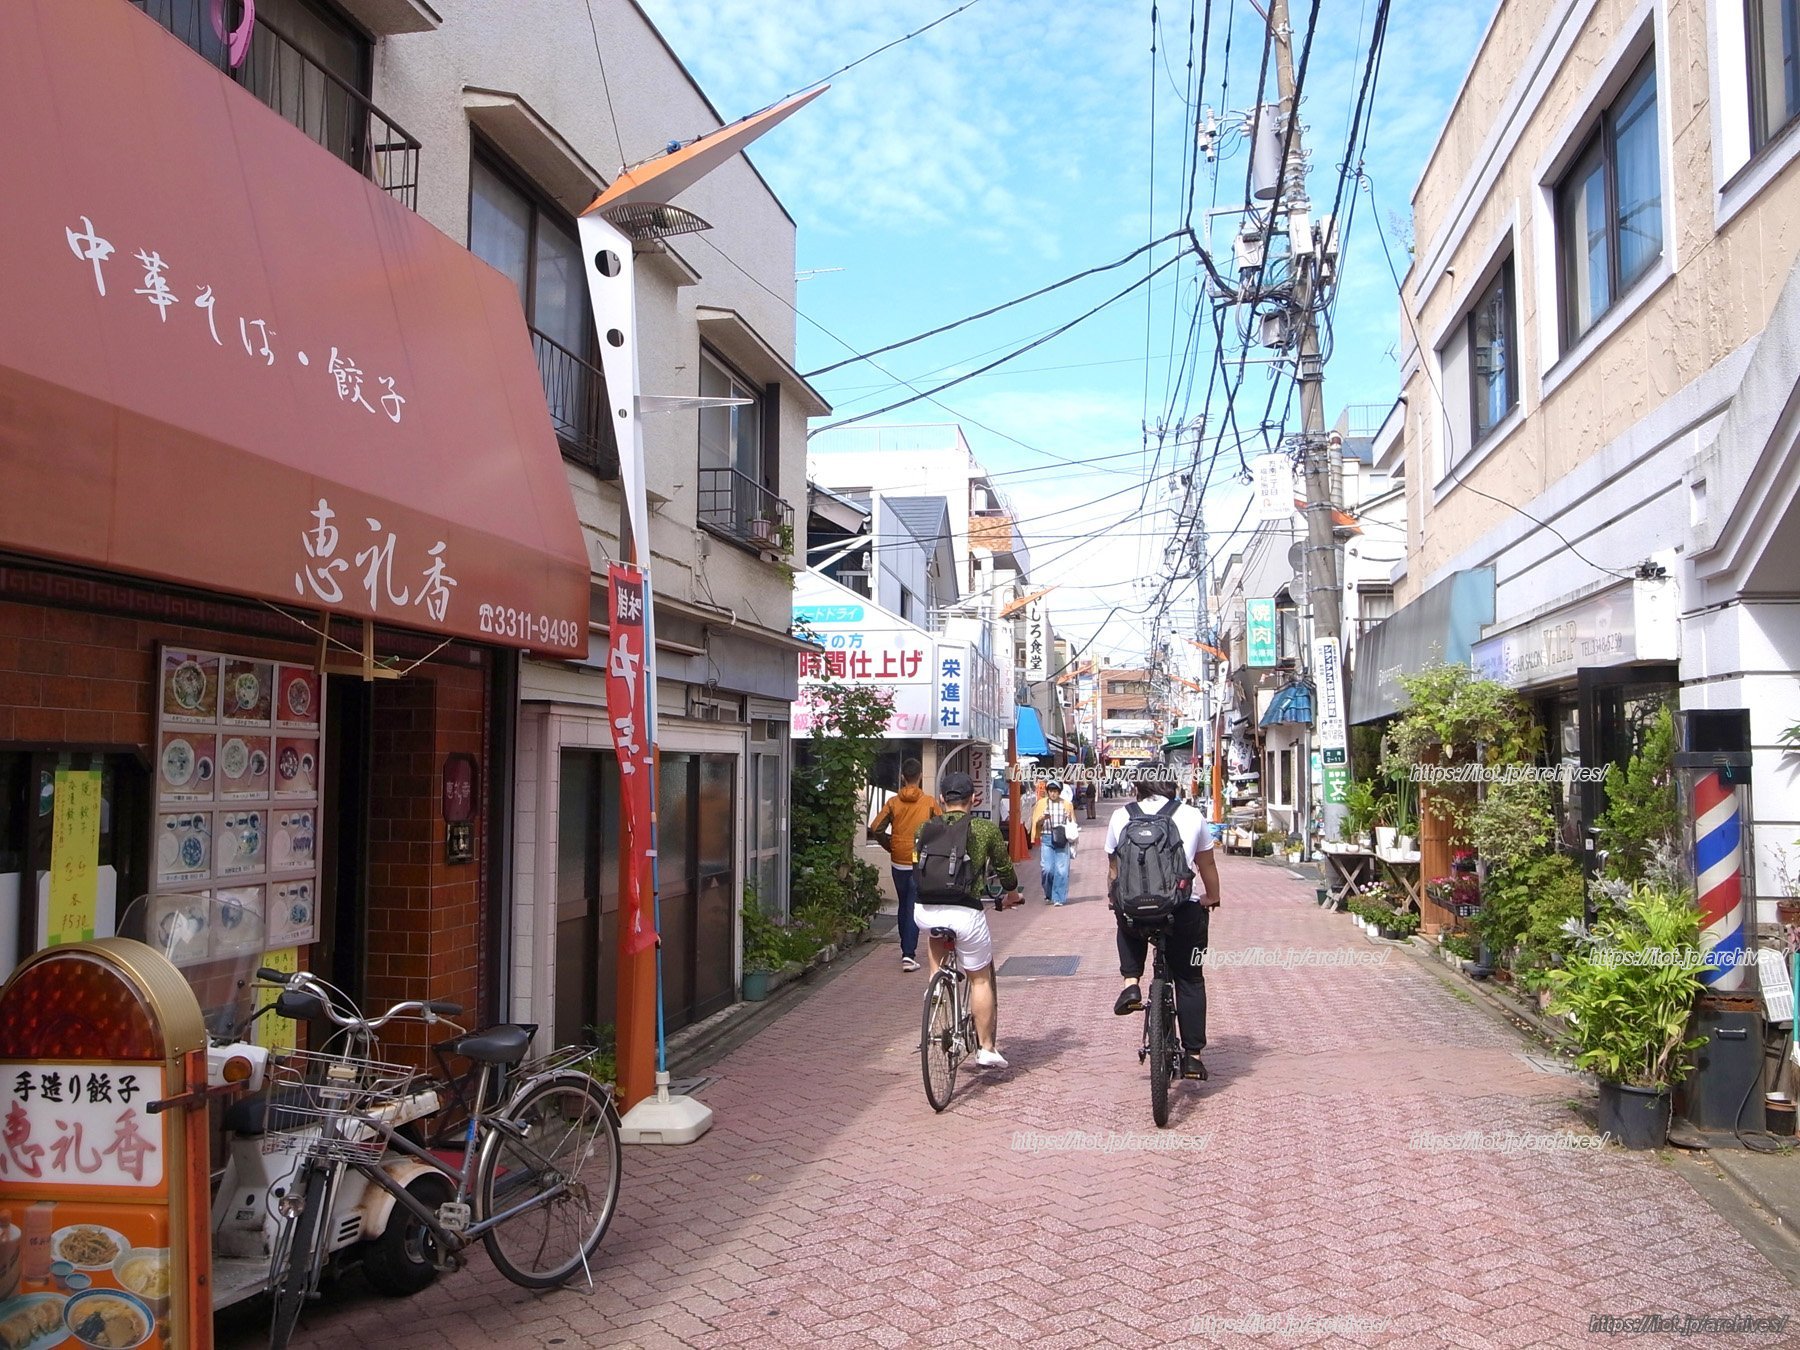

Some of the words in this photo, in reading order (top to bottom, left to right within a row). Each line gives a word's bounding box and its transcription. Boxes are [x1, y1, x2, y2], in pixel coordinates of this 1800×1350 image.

[295, 498, 458, 623] 恵礼香
[494, 604, 579, 649] 3311-9498
[940, 658, 961, 727] 栄進社
[13, 1071, 140, 1104] 手造り餃子
[1, 1099, 158, 1181] 恵礼香
